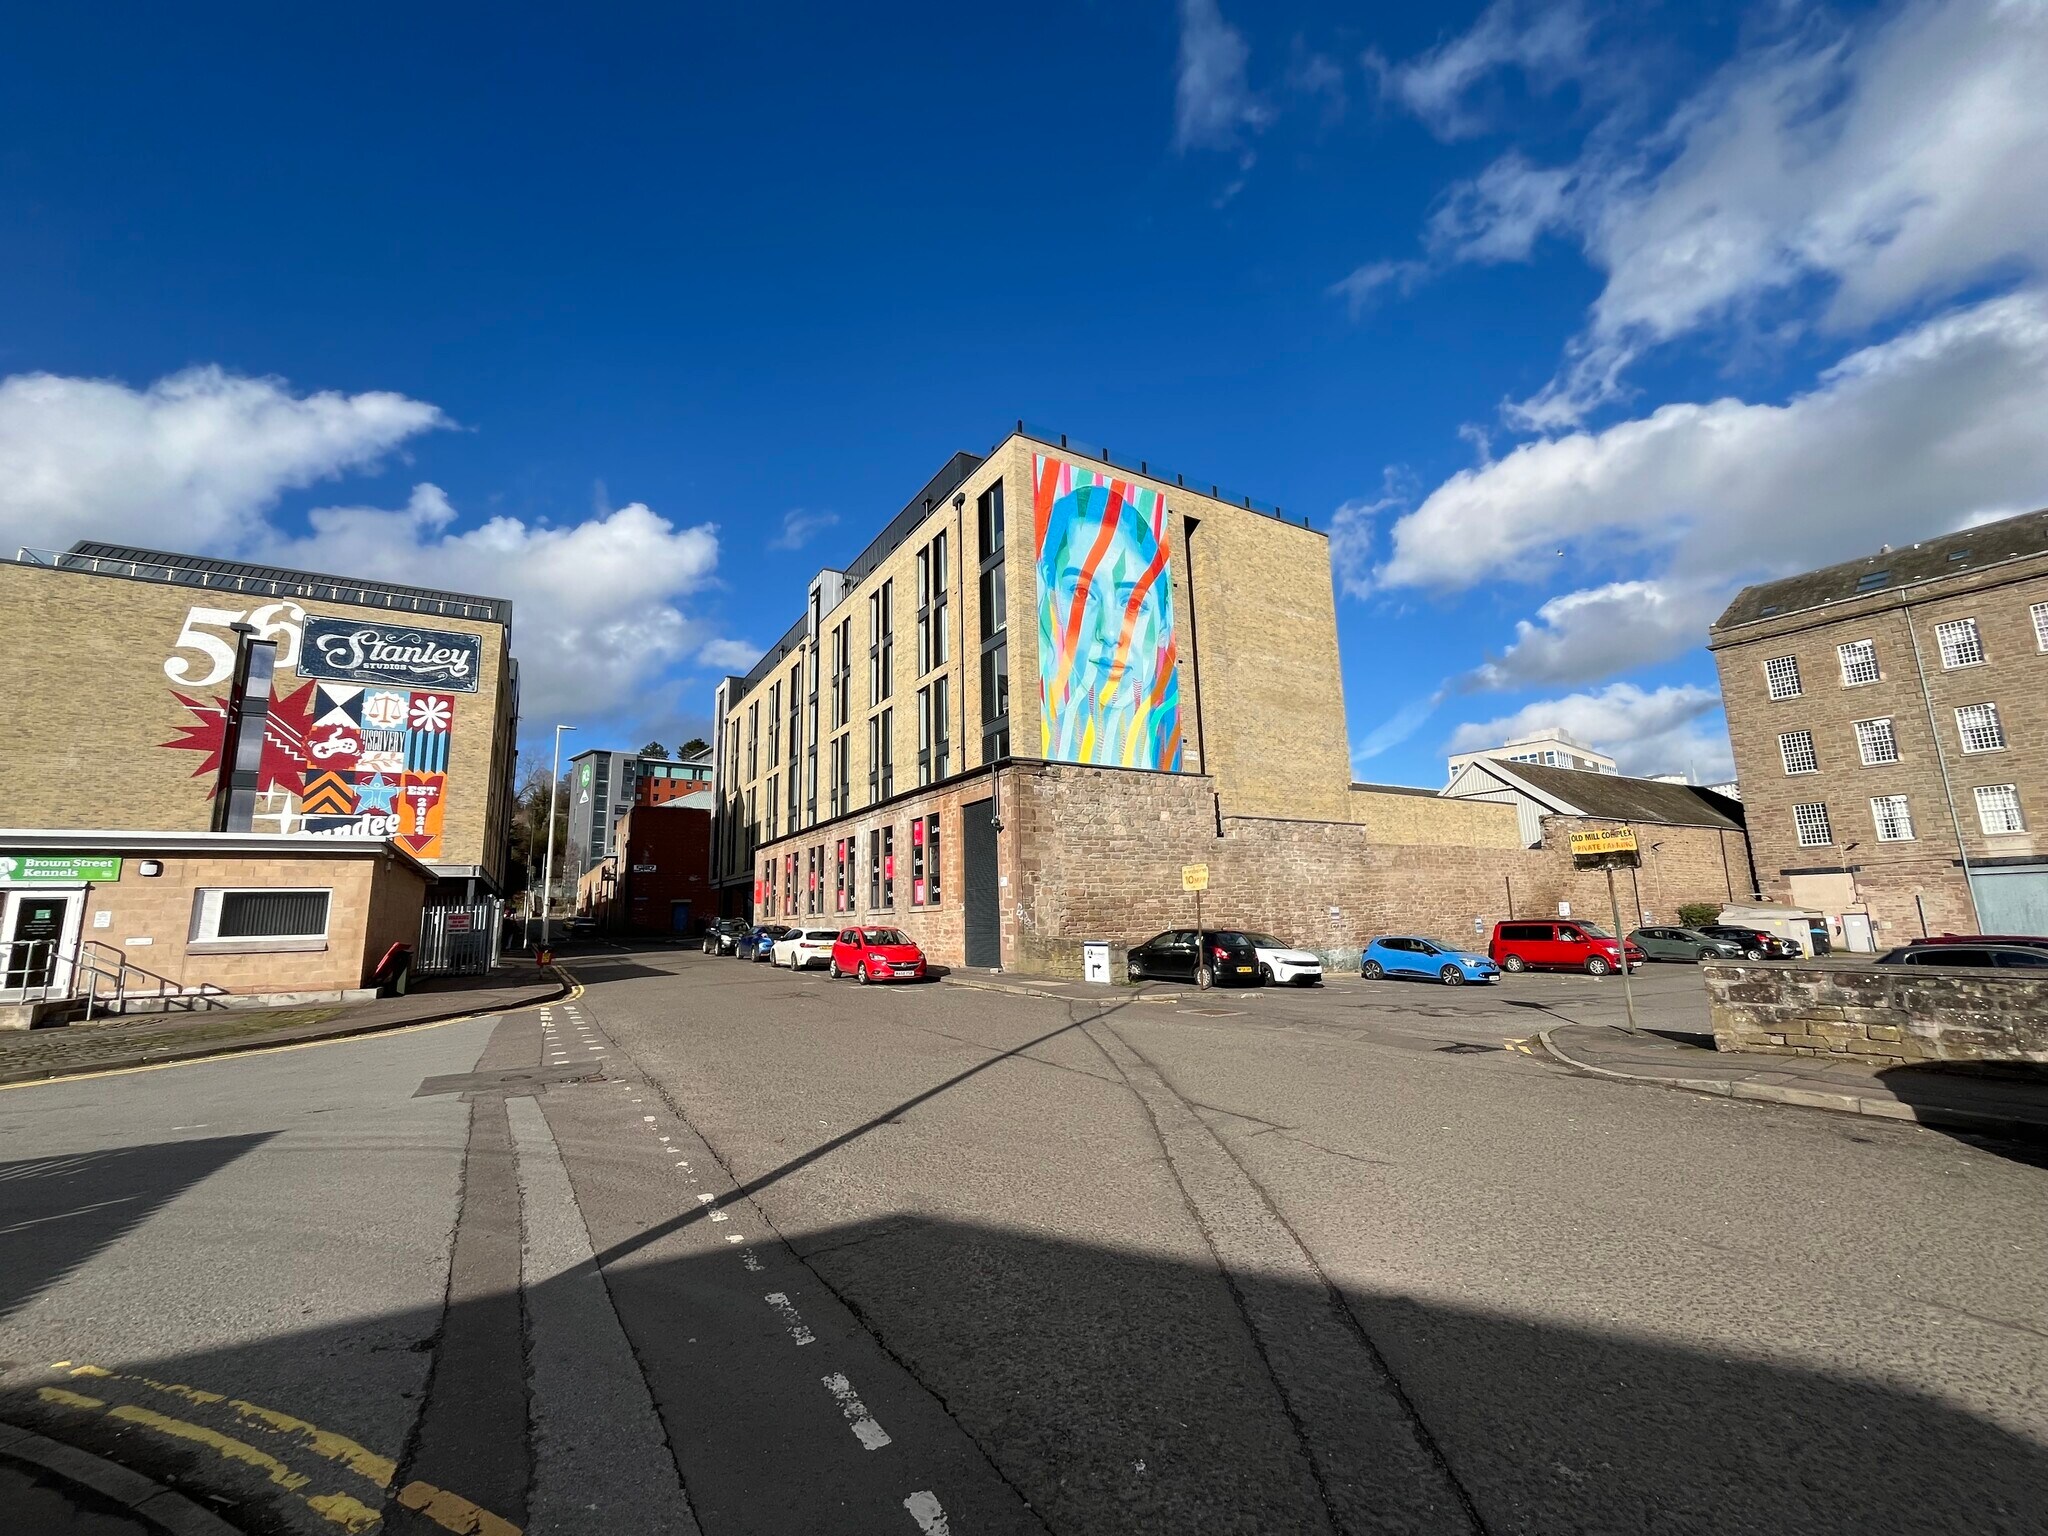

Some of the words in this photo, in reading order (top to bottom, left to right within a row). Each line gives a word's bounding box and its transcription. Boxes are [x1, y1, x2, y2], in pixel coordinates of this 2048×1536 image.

[163, 597, 306, 687] 56
[316, 630, 470, 678] Stanley
[362, 662, 408, 671] STUDIOS
[407, 785, 440, 796] EST.
[415, 797, 427, 835] 2024
[296, 814, 400, 836] ndee
[1571, 834, 1583, 842] OLD
[1585, 833, 1600, 841] MILL
[24, 858, 71, 866] Brown
[72, 858, 113, 867] Street
[23, 869, 78, 877] Kennels
